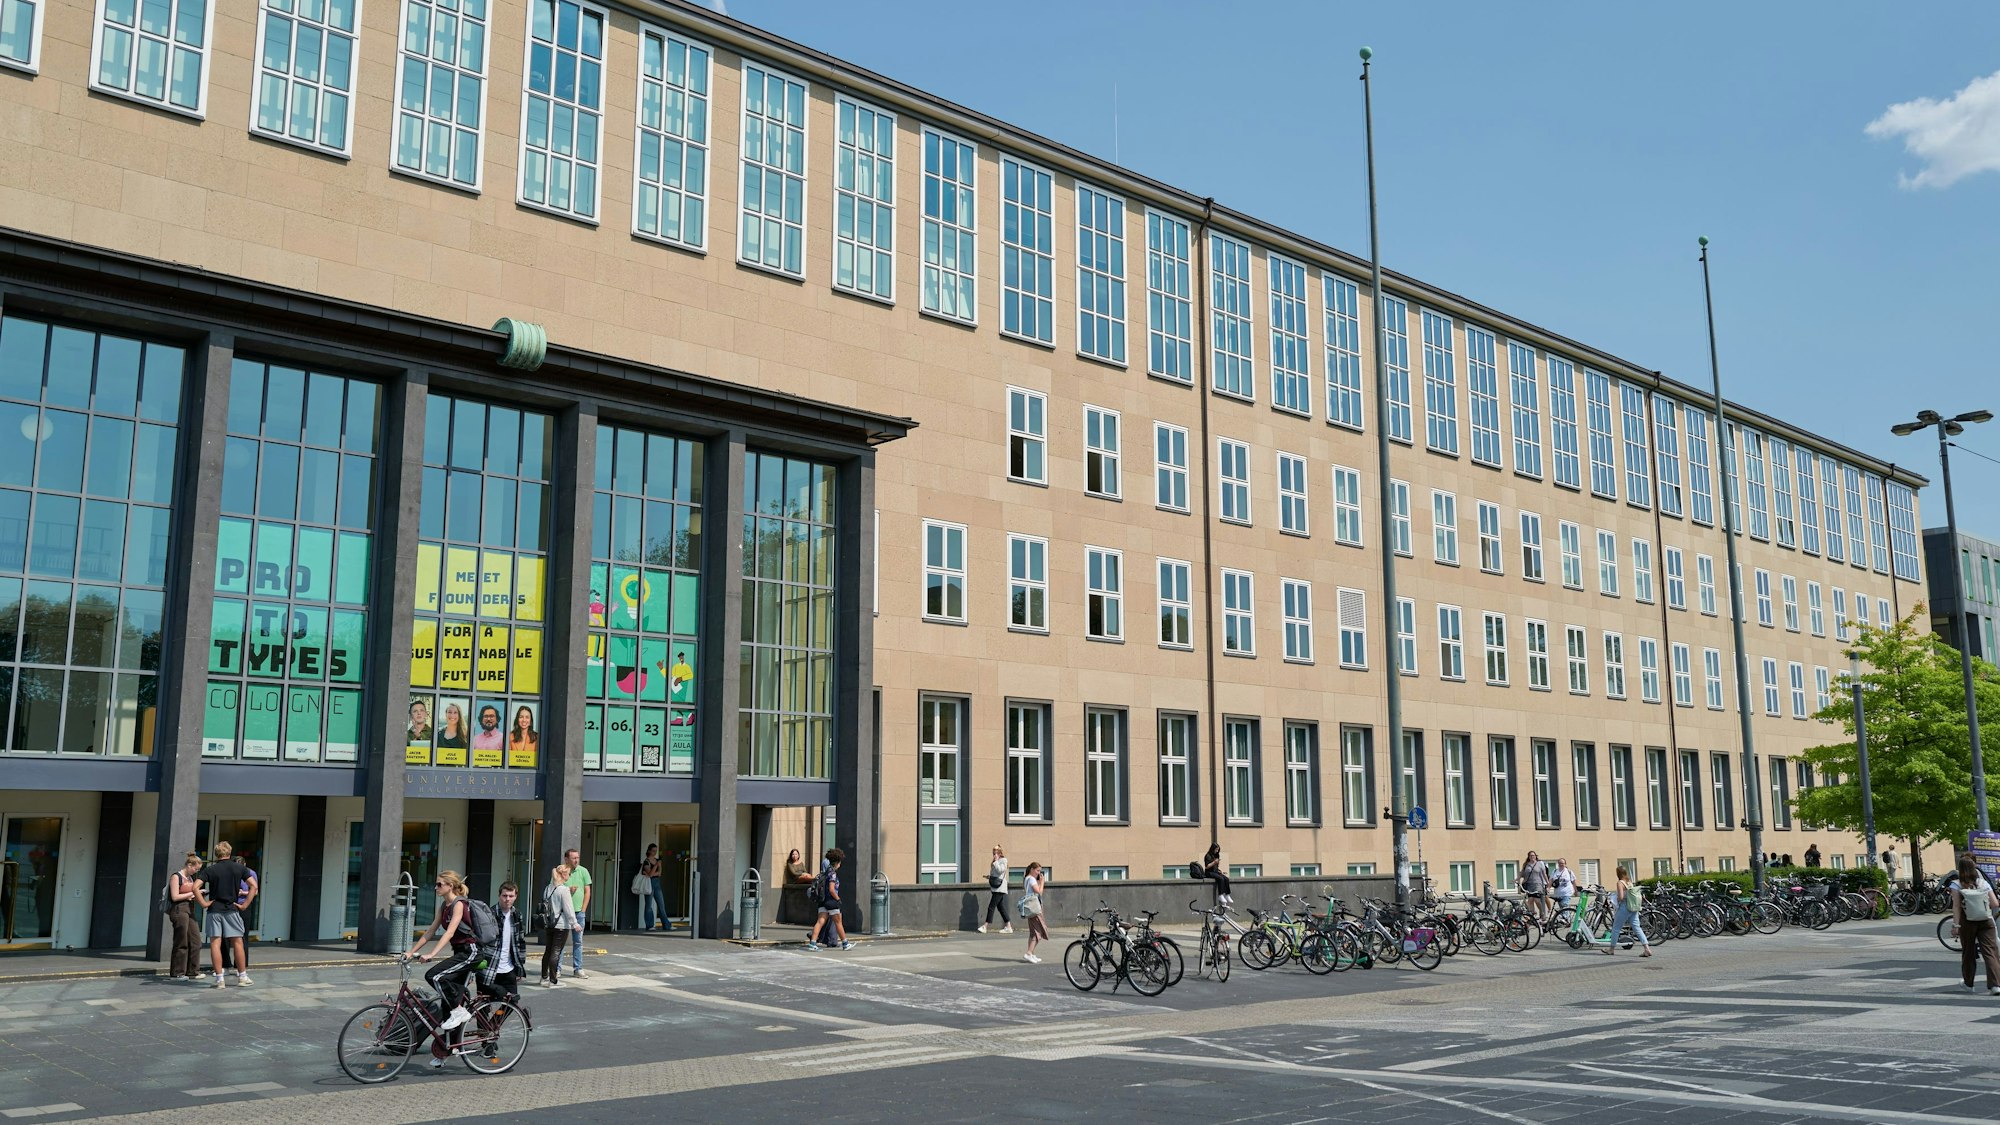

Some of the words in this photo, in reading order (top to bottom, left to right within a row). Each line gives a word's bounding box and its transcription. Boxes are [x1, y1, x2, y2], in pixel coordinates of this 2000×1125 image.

[220, 558, 311, 593] PRO
[456, 572, 501, 583] MEET
[429, 592, 526, 604] FOUNDERS
[254, 608, 308, 640] TO
[444, 626, 472, 637] FOR
[484, 627, 493, 637] A
[213, 639, 347, 677] TYPES
[442, 671, 505, 681] FUTURE
[210, 689, 345, 714] COLOGNE
[585, 720, 599, 730] 2.
[611, 720, 632, 731] 06.
[645, 724, 659, 736] 23
[407, 774, 532, 786] UNIVERSITÄT
